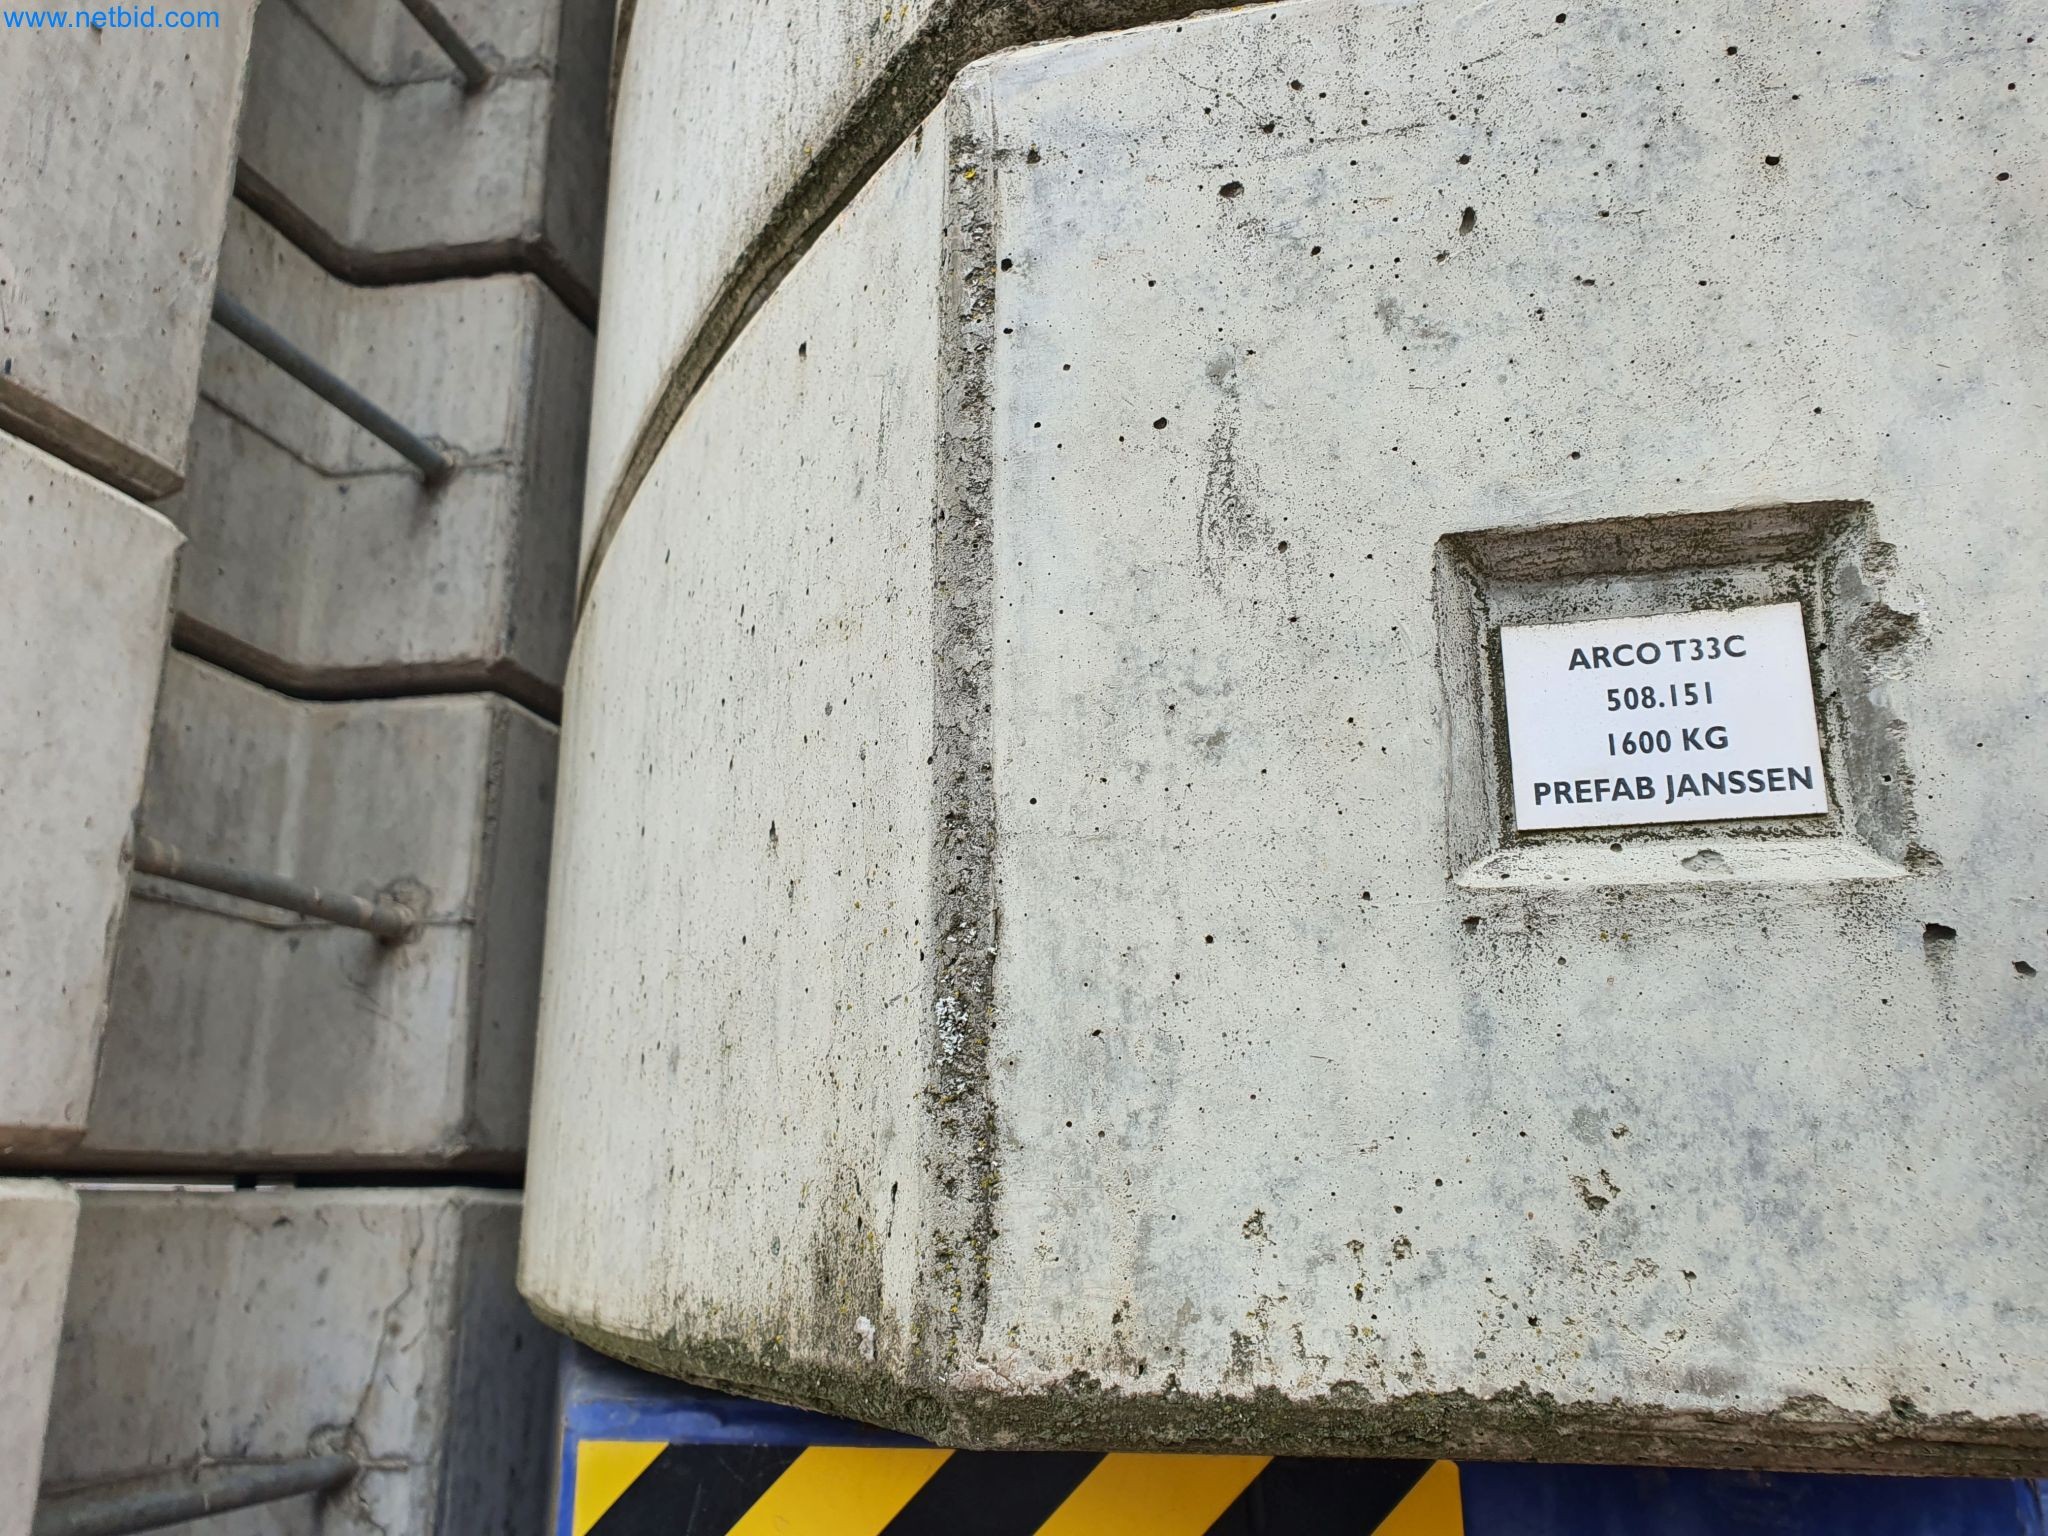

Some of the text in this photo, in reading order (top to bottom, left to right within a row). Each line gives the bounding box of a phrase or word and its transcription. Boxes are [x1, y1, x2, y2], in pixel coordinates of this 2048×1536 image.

[1568, 634, 1747, 671] ARCO T33C
[1607, 681, 1713, 711] 508.151
[1608, 725, 1729, 756] 1600 KG
[1533, 766, 1814, 806] PREFAB JANSSEN
